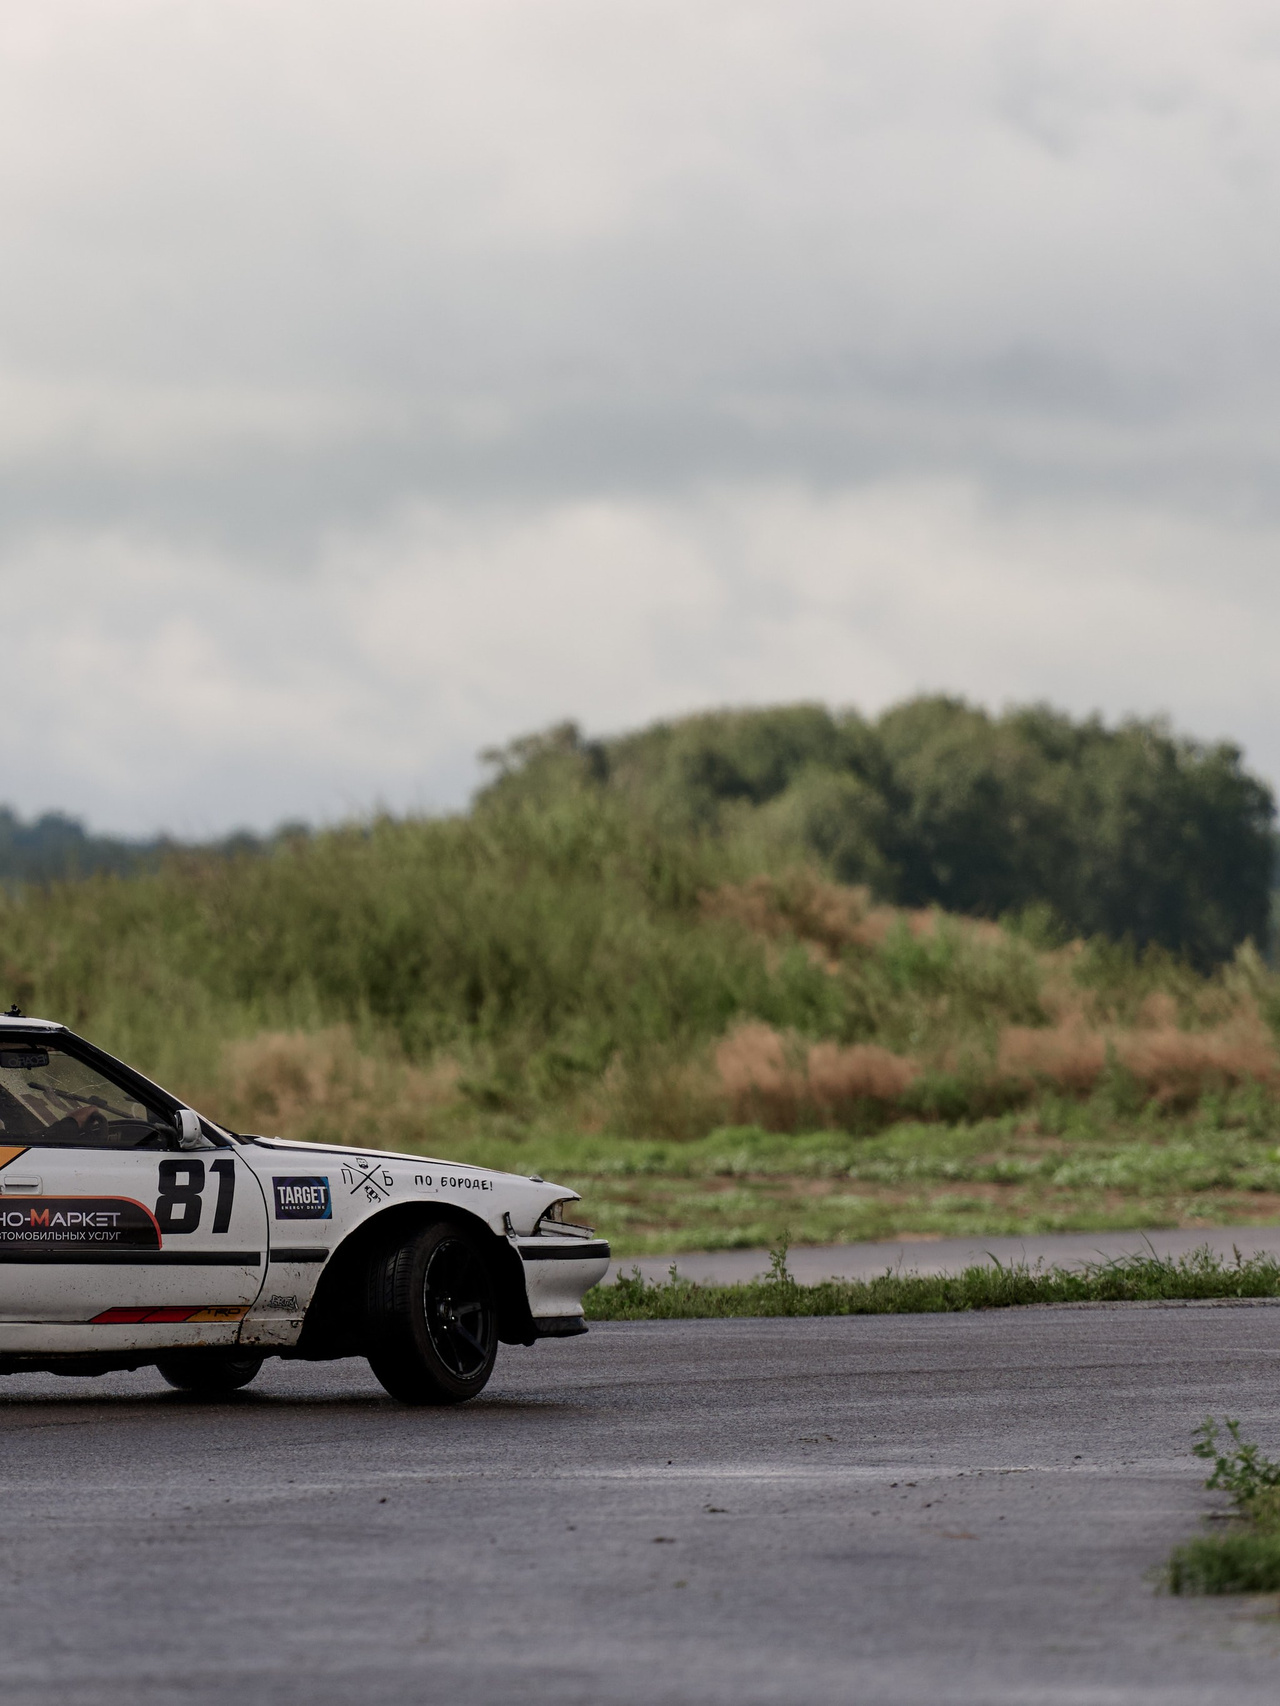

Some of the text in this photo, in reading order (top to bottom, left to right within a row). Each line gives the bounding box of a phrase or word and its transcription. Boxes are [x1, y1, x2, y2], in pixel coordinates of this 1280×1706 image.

[415, 1175, 493, 1191] ПО БОРОДЕ!
[155, 1159, 235, 1234] 81
[277, 1186, 327, 1204] TARGET
[88, 1231, 121, 1241] УСЛУГ
